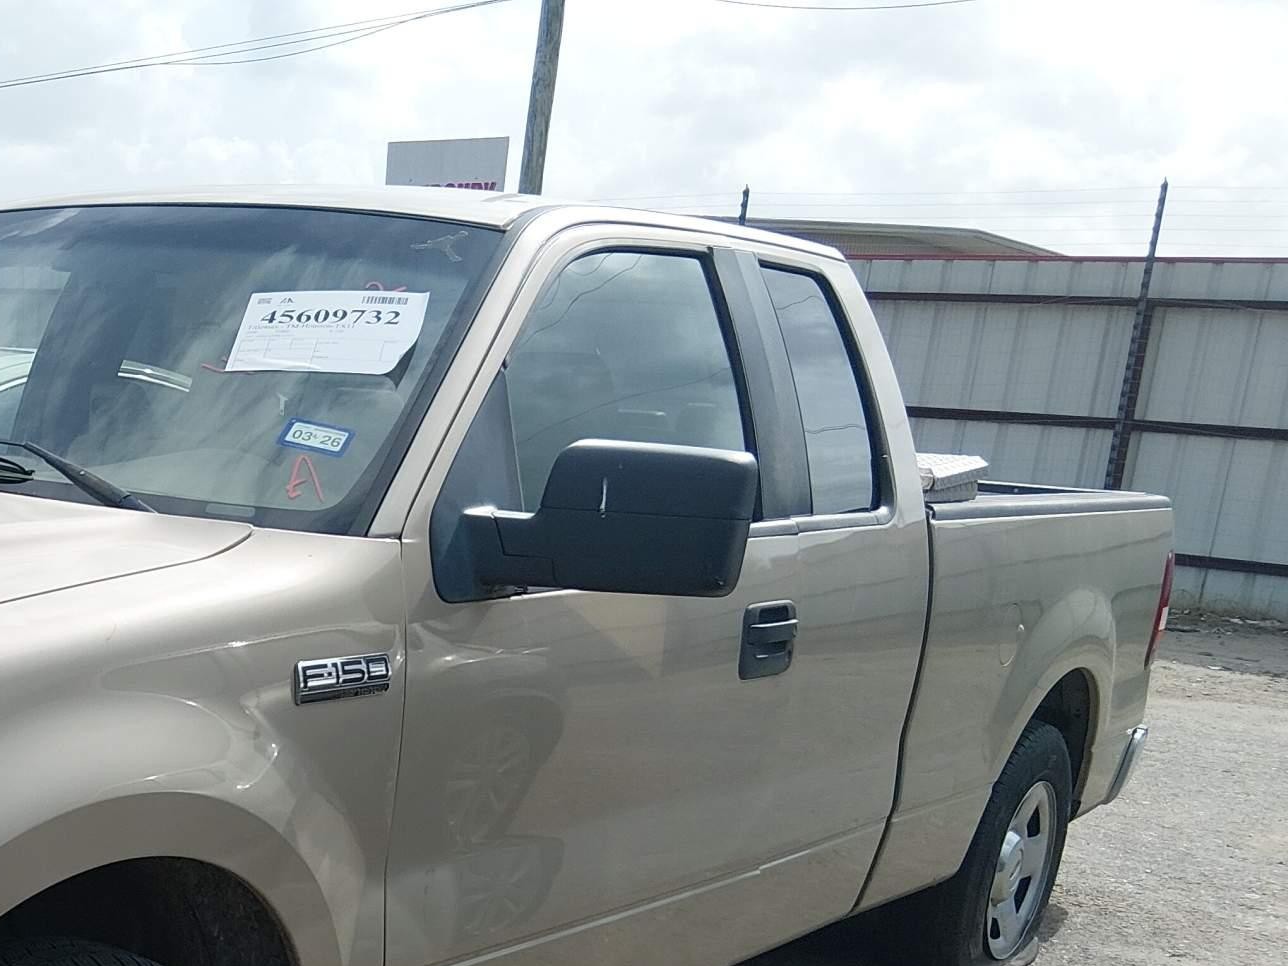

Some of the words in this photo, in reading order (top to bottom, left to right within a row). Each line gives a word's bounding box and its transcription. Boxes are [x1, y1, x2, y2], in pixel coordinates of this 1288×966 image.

[261, 309, 401, 325] 45609732
[292, 429, 313, 441] 03
[319, 435, 342, 448] 26
